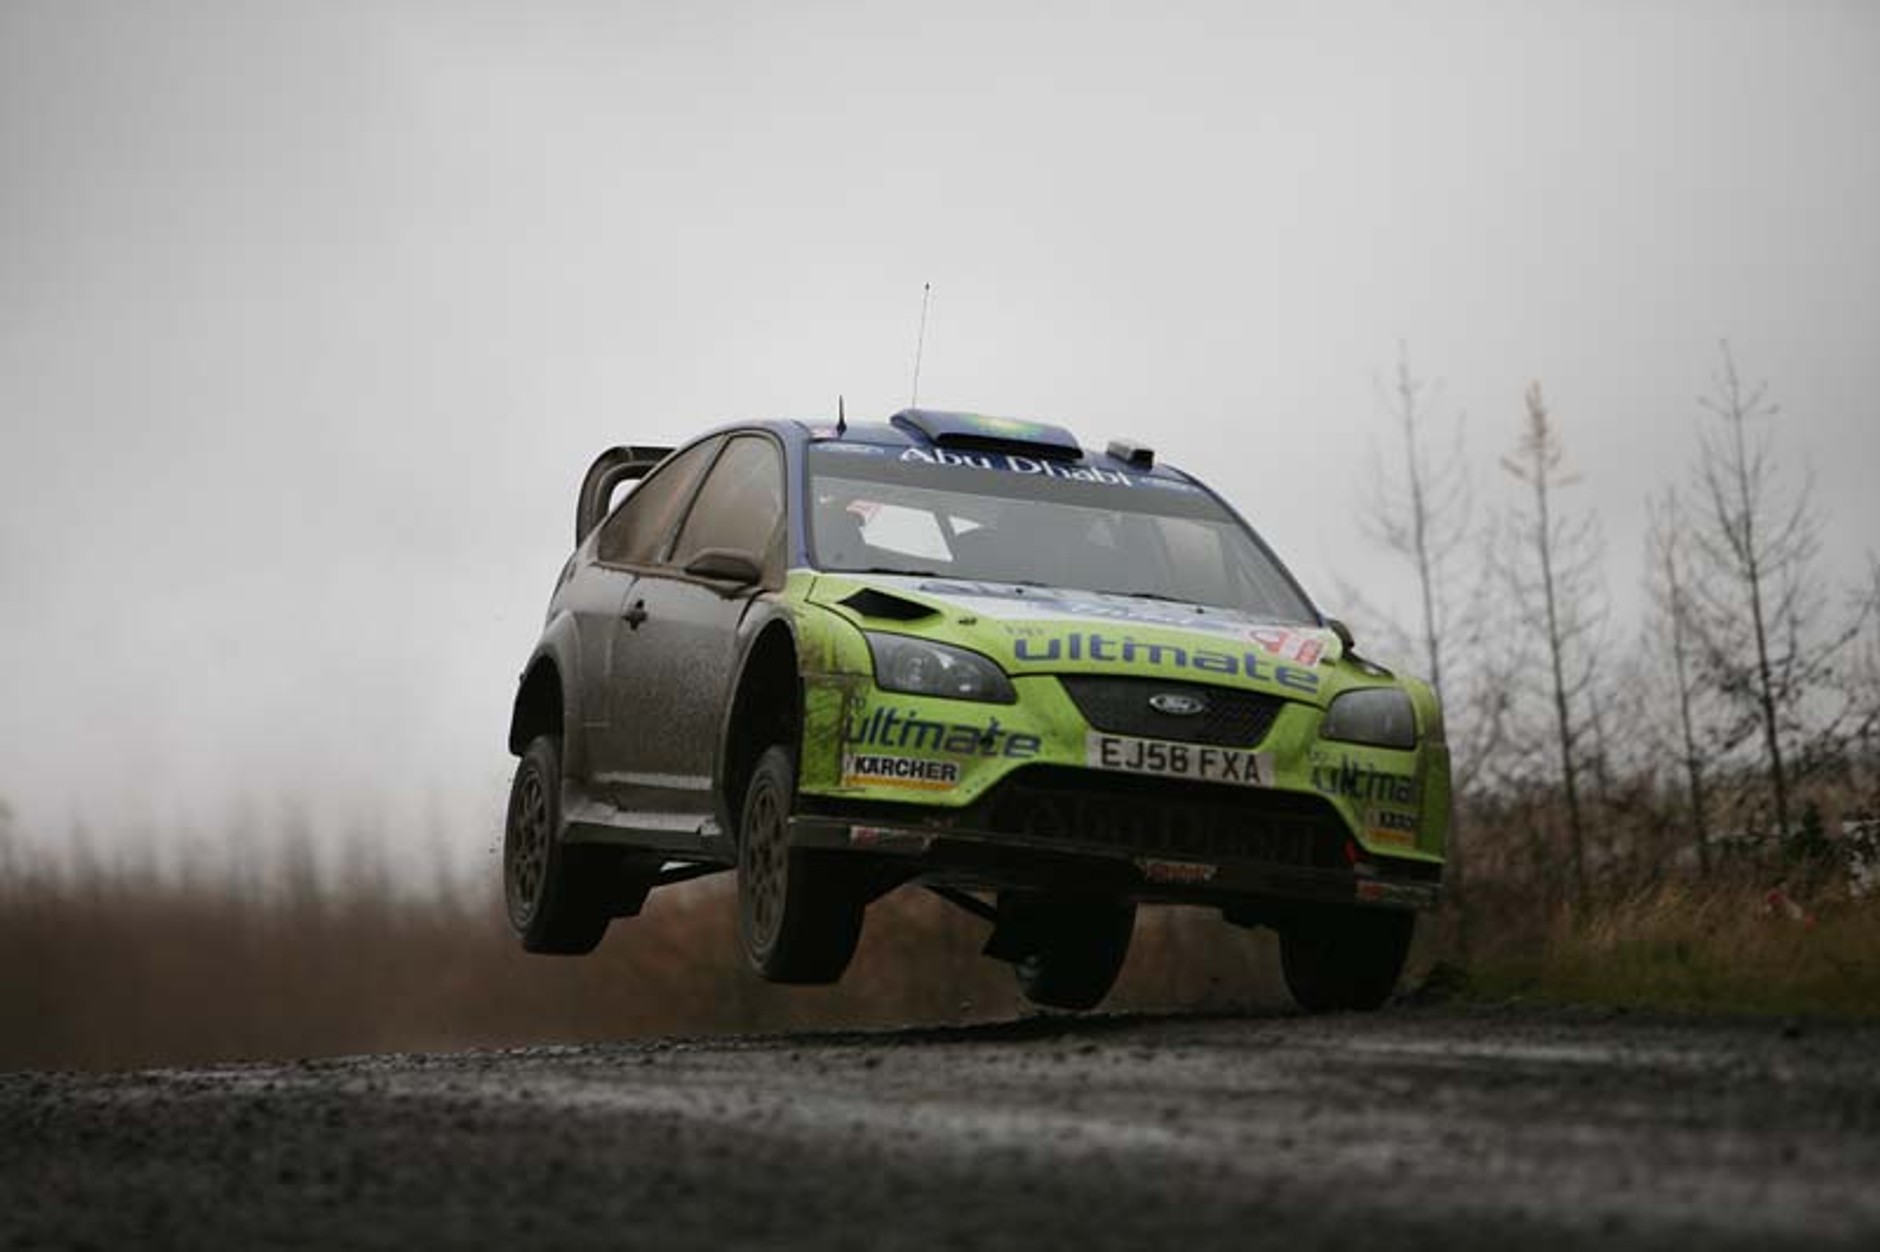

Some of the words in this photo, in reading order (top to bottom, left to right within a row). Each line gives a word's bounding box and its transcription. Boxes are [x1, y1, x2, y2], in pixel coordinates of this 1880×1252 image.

[900, 446, 992, 471] Abu
[1013, 632, 1321, 694] ultimate
[846, 706, 1042, 758] ultimate
[1199, 748, 1261, 784] FXA
